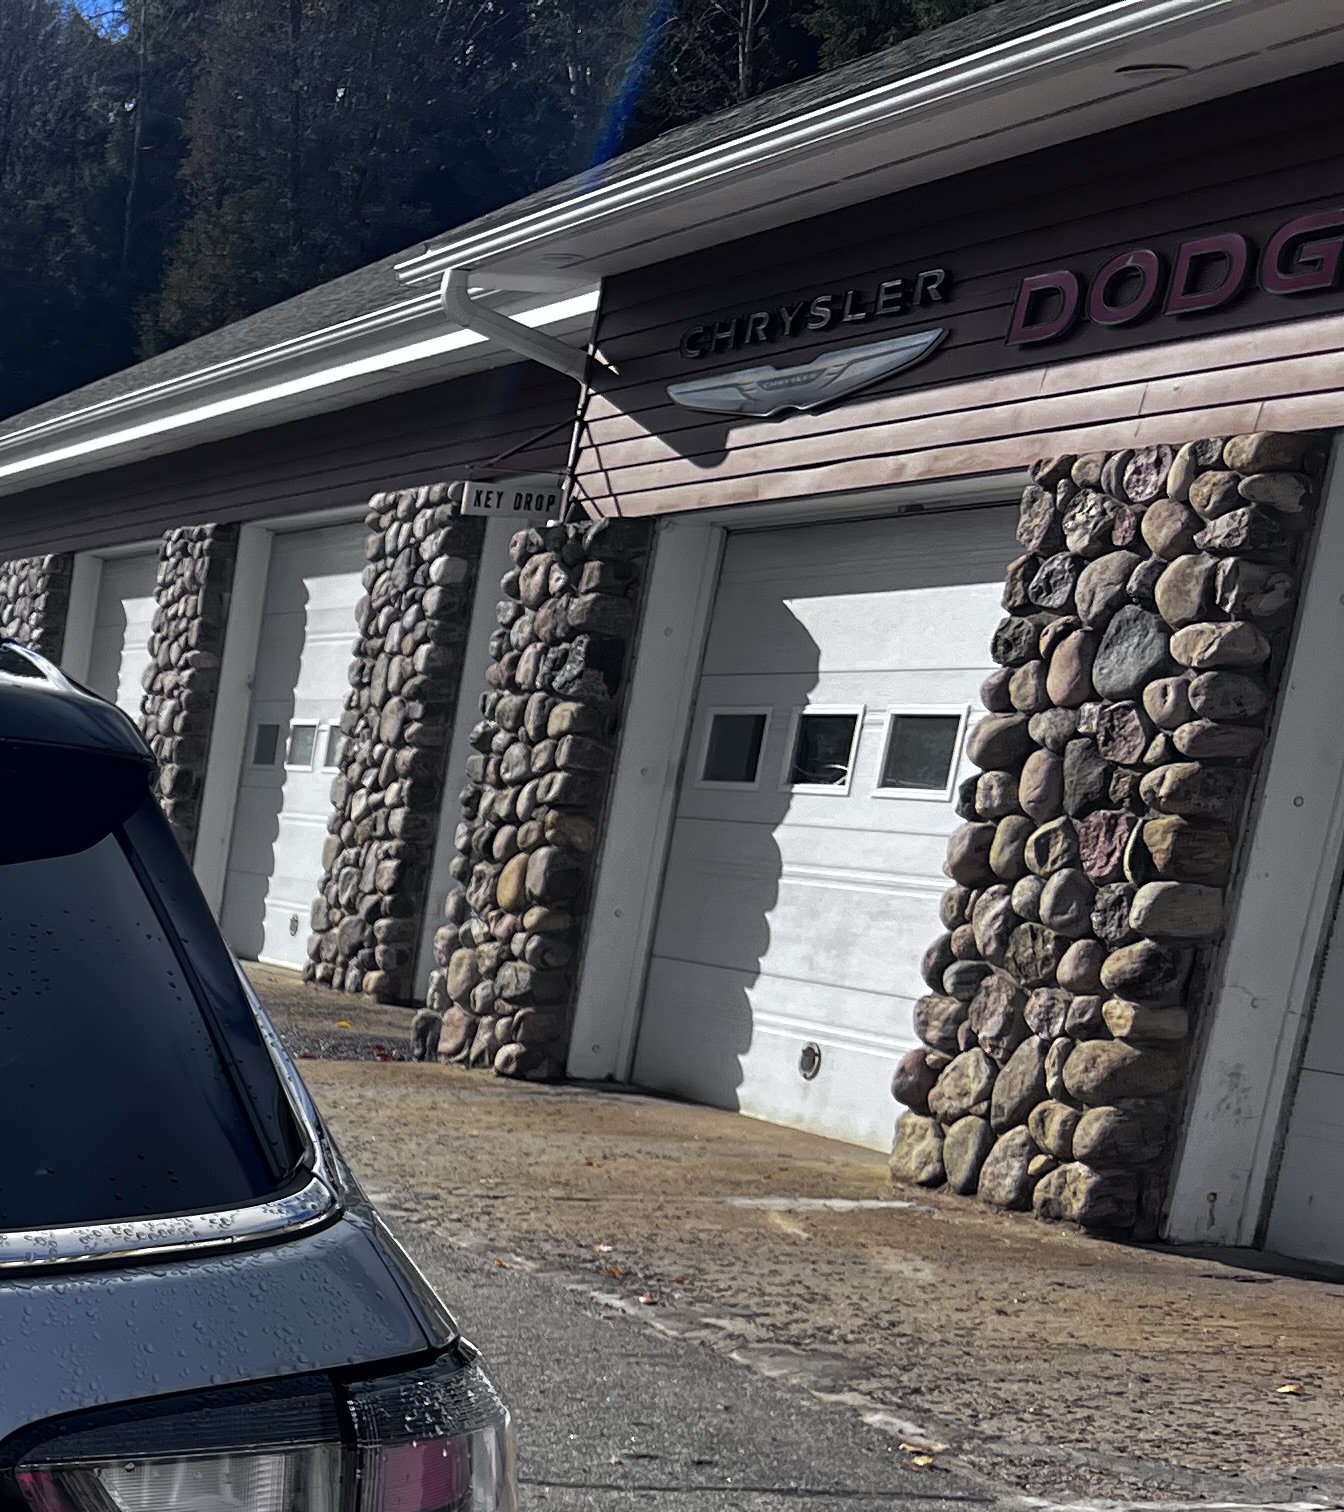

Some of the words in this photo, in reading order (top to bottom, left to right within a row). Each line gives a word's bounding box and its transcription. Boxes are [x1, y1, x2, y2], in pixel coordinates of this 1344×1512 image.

[679, 267, 948, 358] CHRYSLER
[473, 489, 504, 509] KEY
[513, 492, 557, 512] DROP
